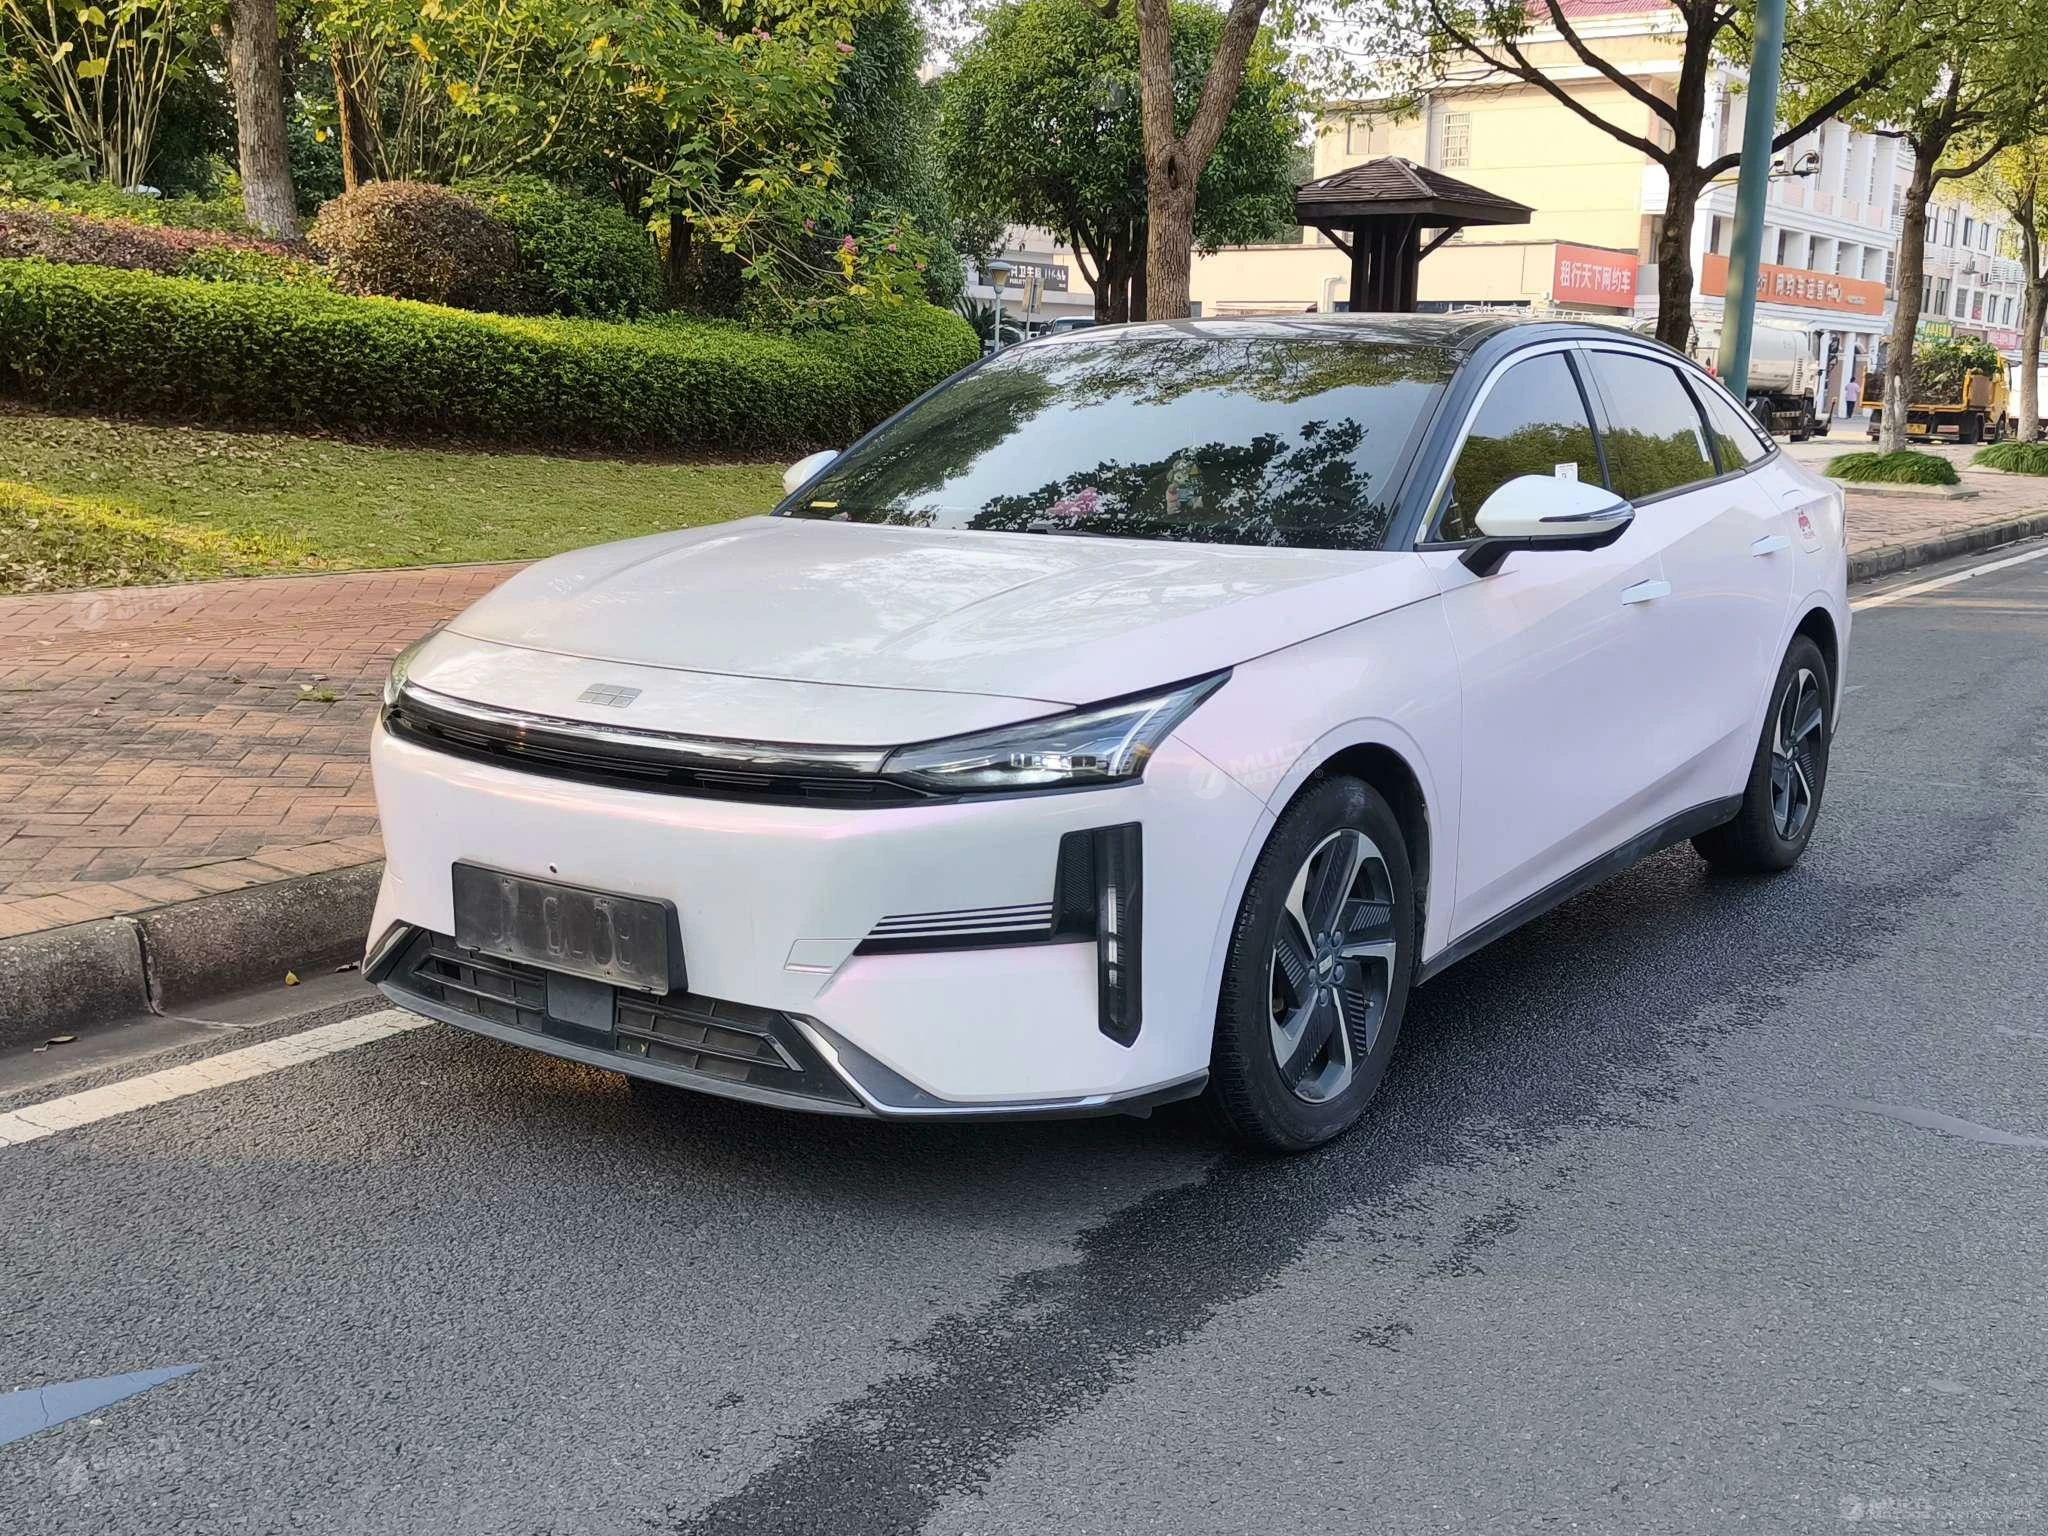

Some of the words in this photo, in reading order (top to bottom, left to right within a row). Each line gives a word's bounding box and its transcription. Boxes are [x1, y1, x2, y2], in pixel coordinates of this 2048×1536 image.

[1560, 260, 1632, 294] 租行天下网约车
